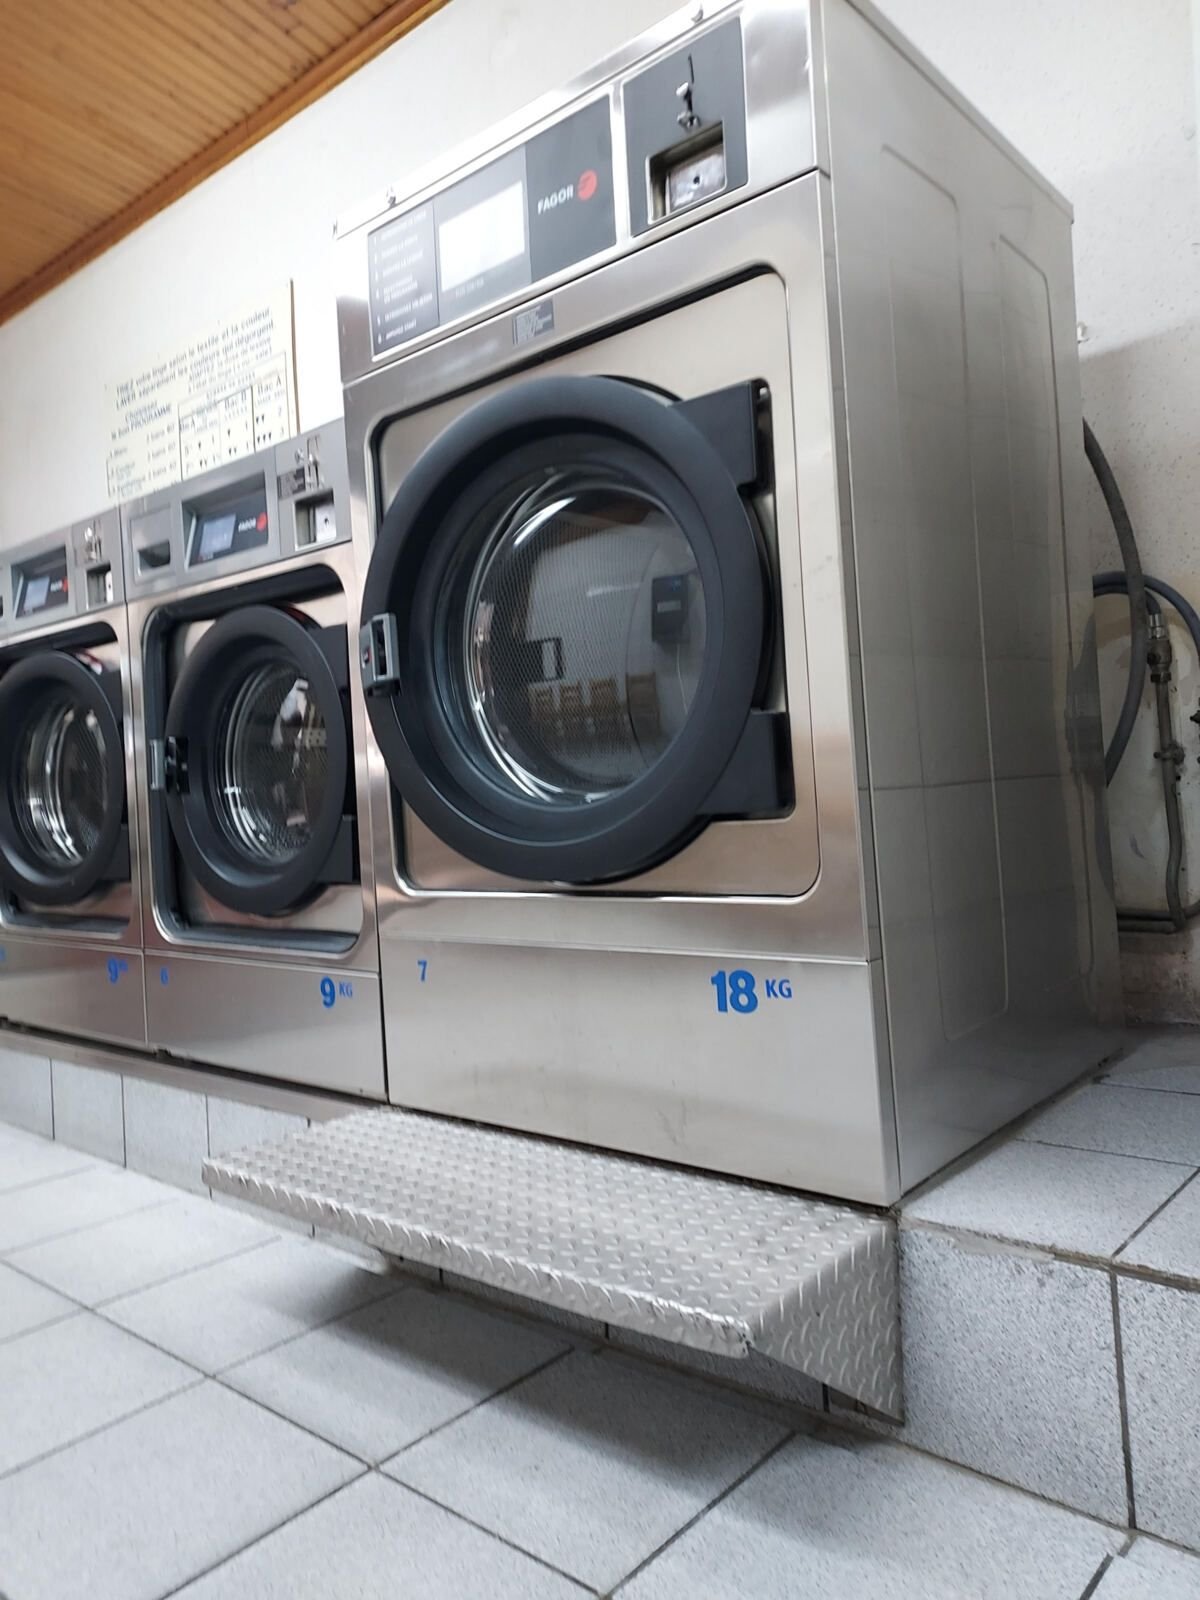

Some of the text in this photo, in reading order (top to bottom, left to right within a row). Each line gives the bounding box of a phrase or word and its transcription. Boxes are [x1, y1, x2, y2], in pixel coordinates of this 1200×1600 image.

[537, 184, 574, 215] FAGOR
[241, 306, 270, 330] couleur
[107, 957, 119, 983] 9
[417, 960, 428, 981] 7
[320, 976, 353, 1009] 9 KG
[710, 969, 792, 1014] 18 KG
